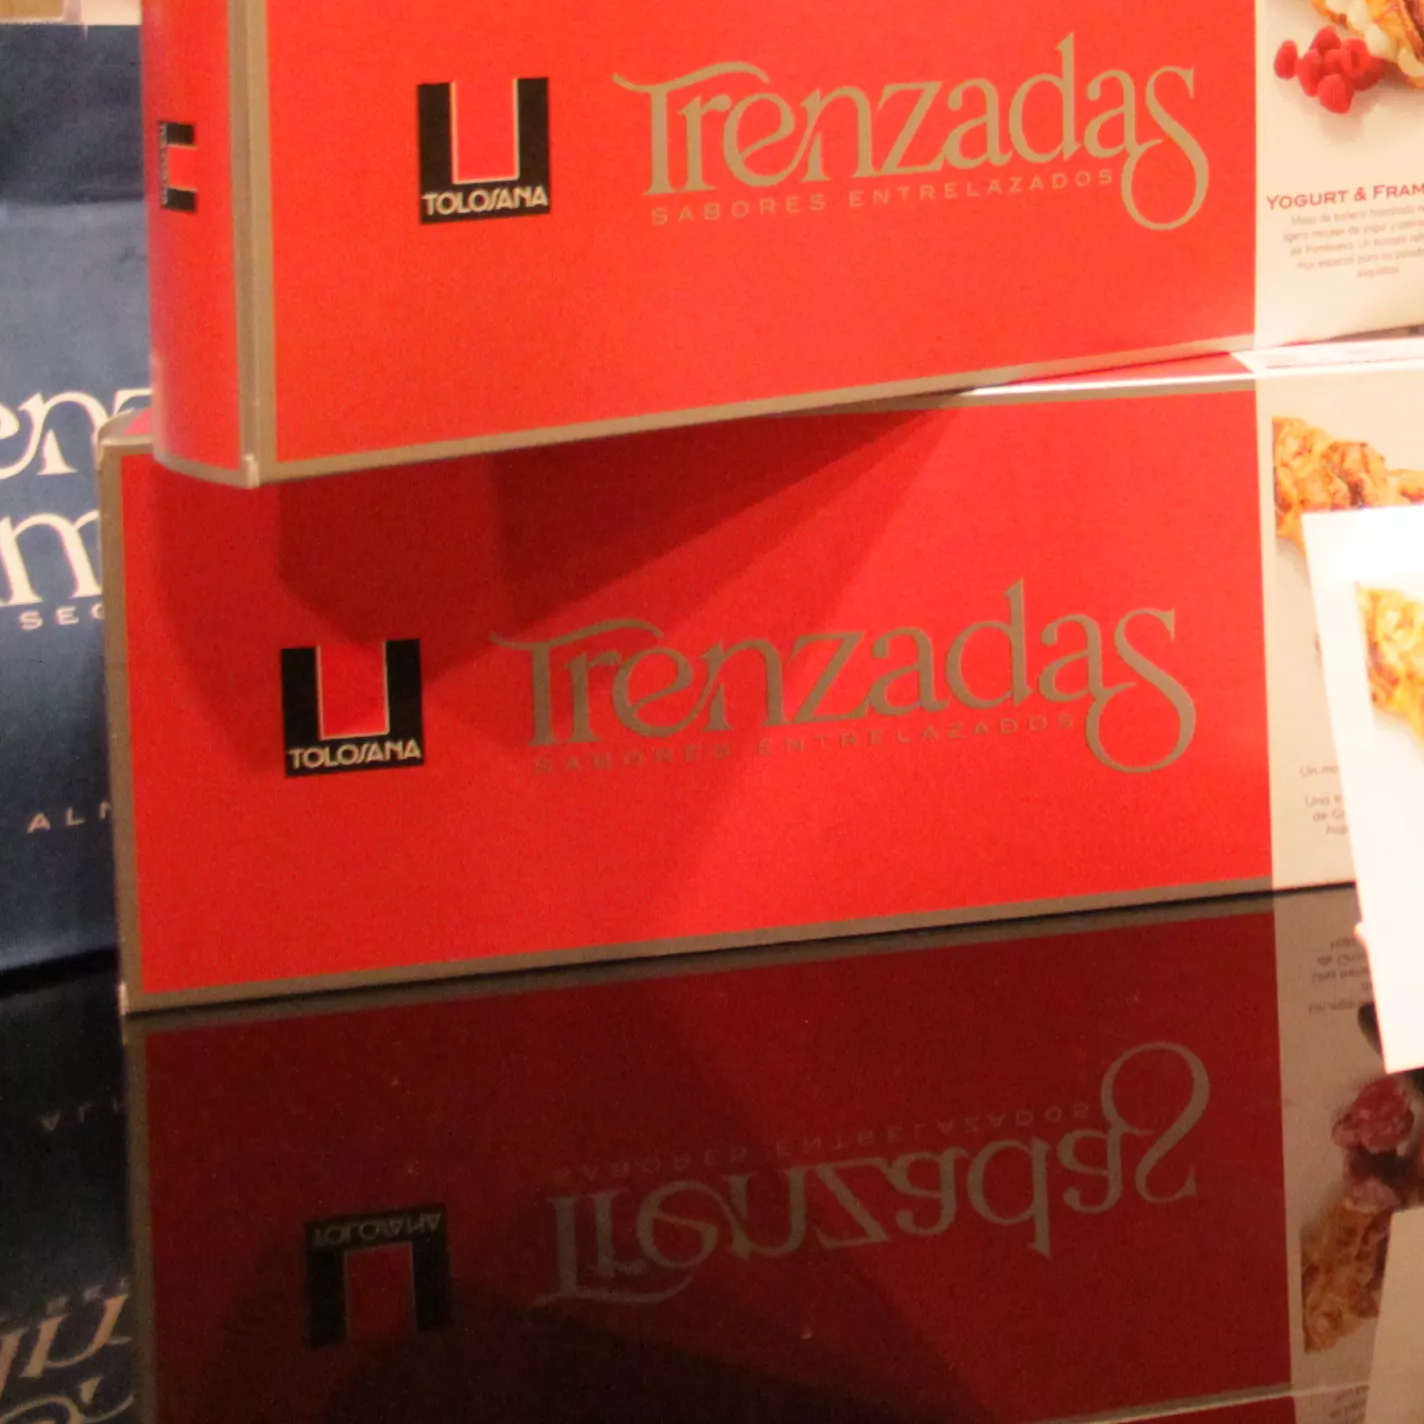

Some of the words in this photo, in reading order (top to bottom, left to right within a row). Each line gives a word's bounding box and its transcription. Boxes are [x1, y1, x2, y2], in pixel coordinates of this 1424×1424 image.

[612, 31, 1210, 232] Trenzadas
[421, 184, 549, 216] TOLOSANA
[650, 193, 827, 228] SABORES
[848, 168, 1114, 209] ENTRELAZADOS
[1266, 189, 1350, 211] YOGURT
[1354, 186, 1367, 203] &
[490, 576, 1198, 774] Trenzadas
[288, 737, 423, 770] TOLOSANA
[758, 710, 1077, 757] ENTRELAZADOS
